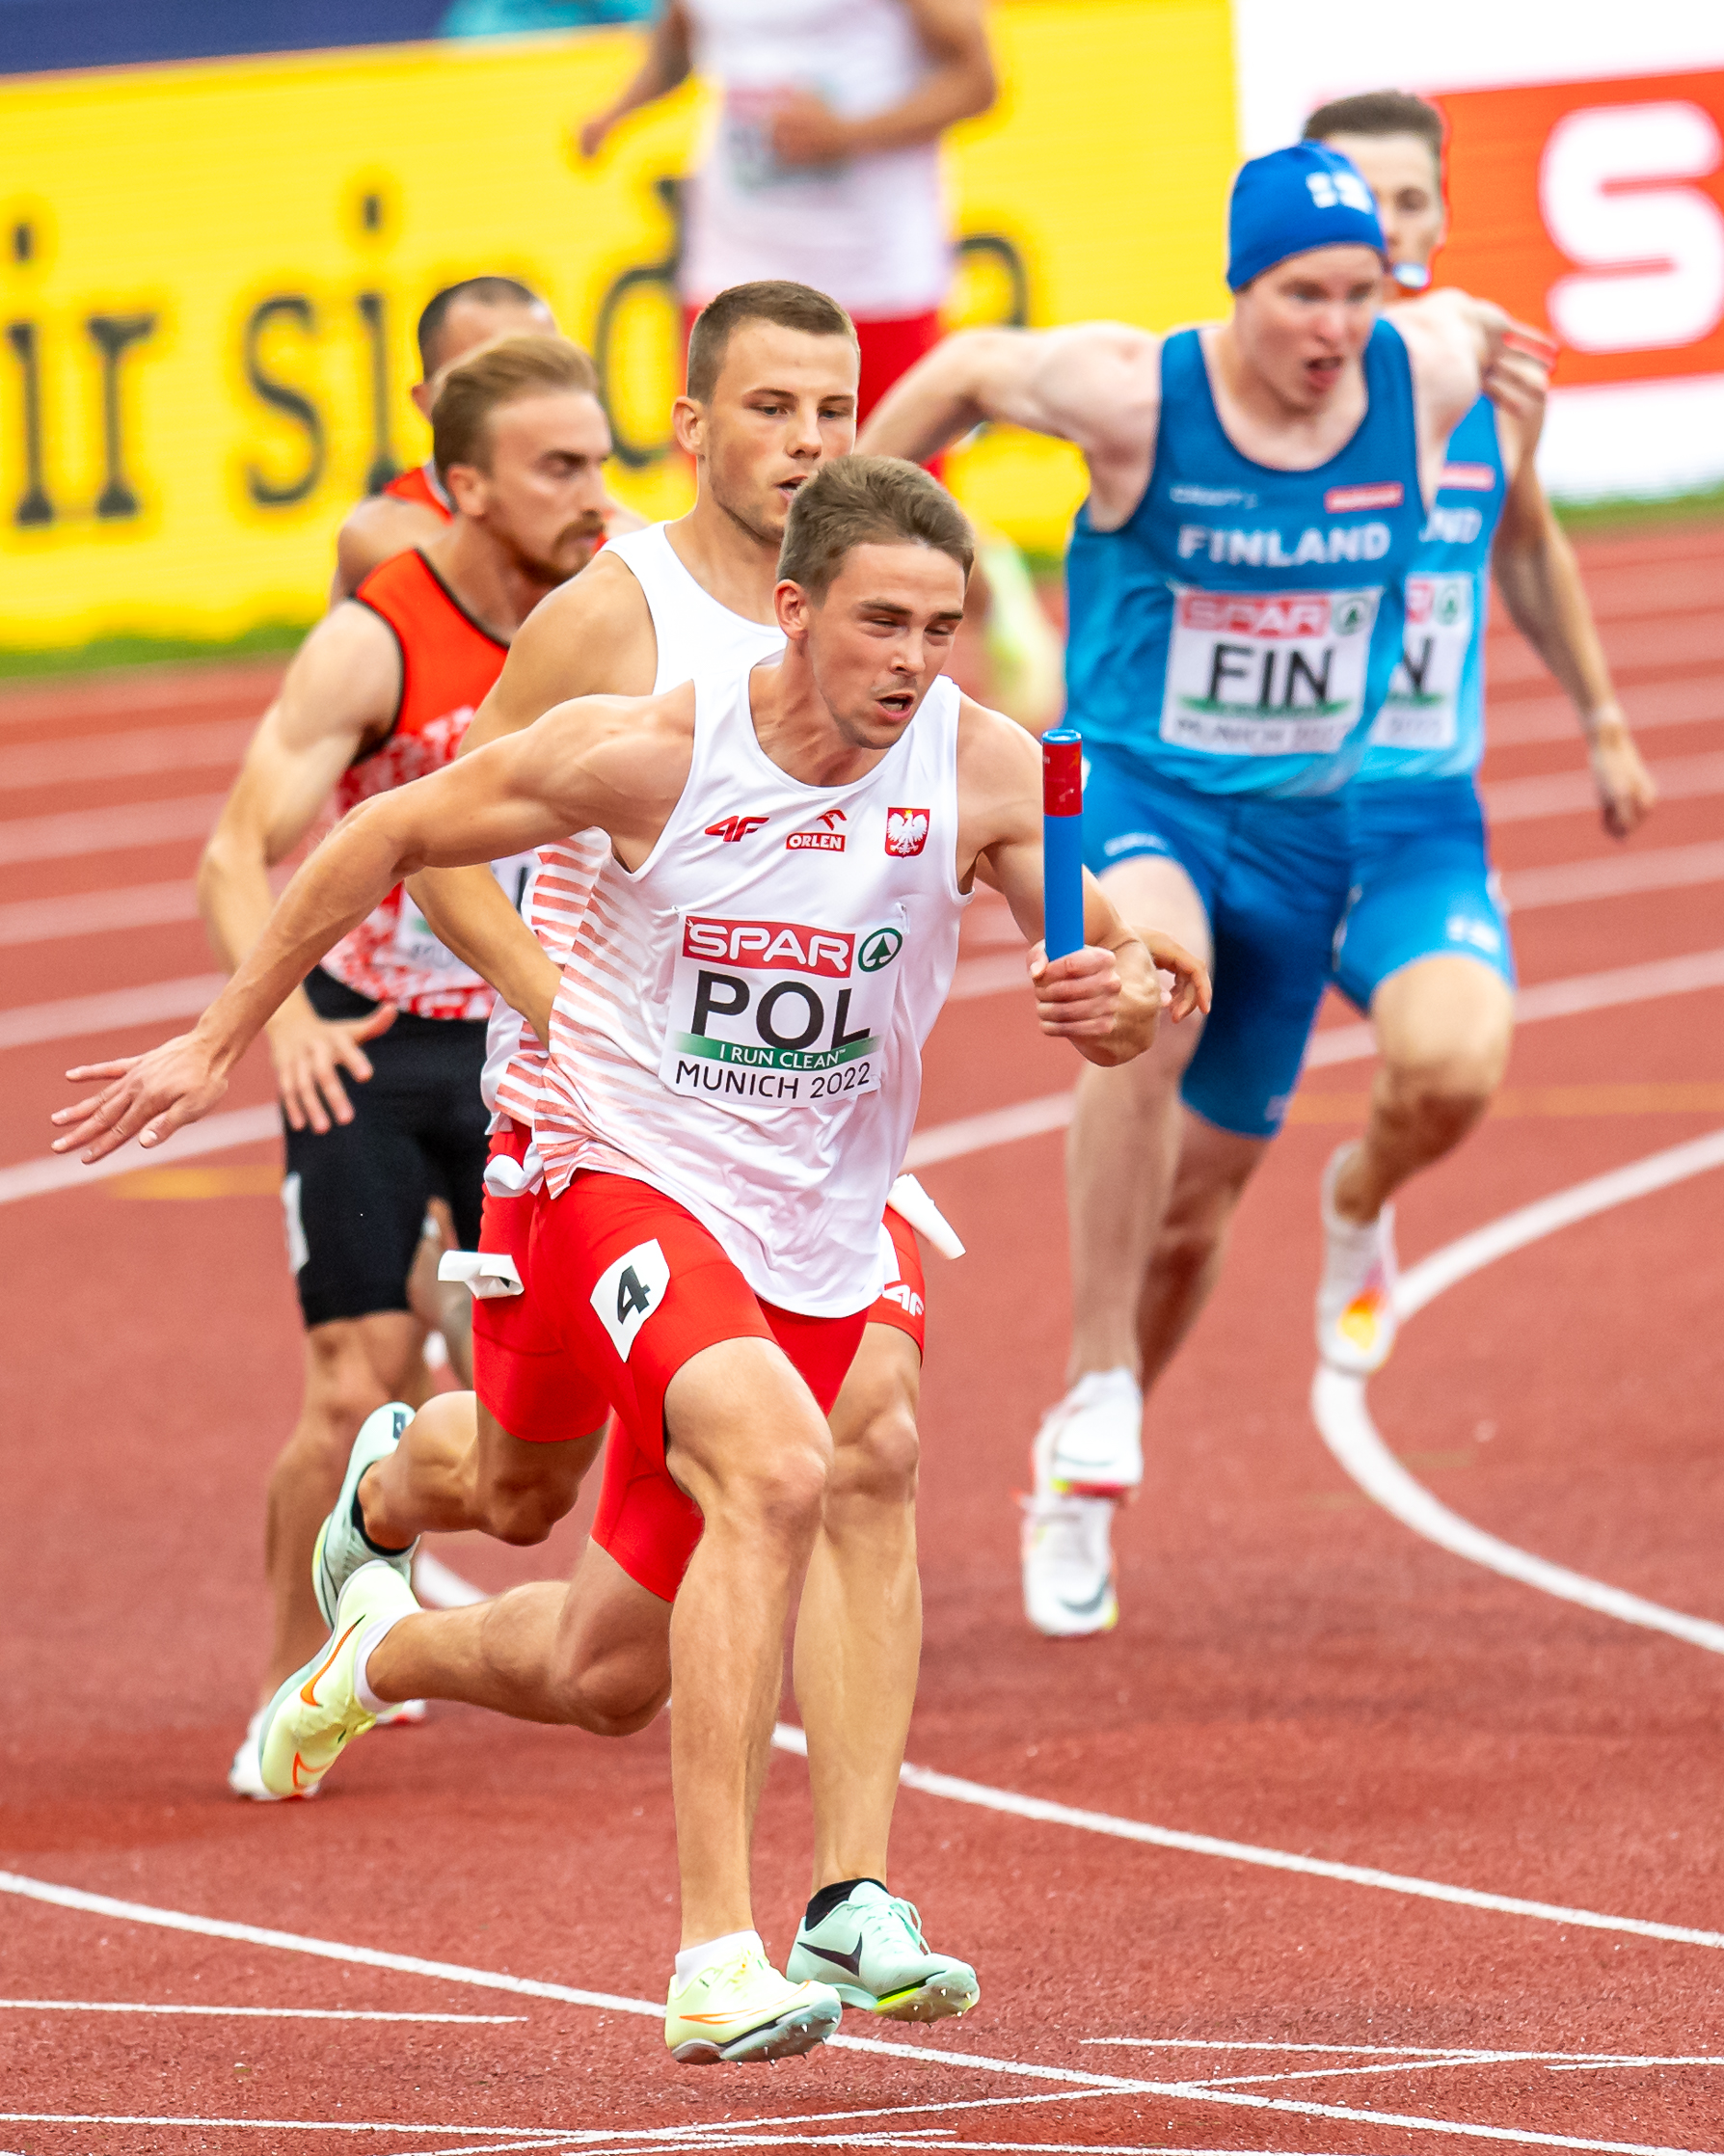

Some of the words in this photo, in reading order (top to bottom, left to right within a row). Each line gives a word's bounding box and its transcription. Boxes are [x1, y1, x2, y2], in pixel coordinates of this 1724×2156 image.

[1177, 523, 1390, 567] FINLAND
[1206, 642, 1334, 710] FIN
[789, 834, 843, 849] ORLEN
[687, 923, 851, 973] SPAR
[690, 968, 872, 1051] POL
[719, 1043, 725, 1059] I
[731, 1046, 773, 1066] RUN
[675, 1061, 799, 1099] MUNICH
[810, 1062, 871, 1099] 2022
[617, 1265, 651, 1325] 4
